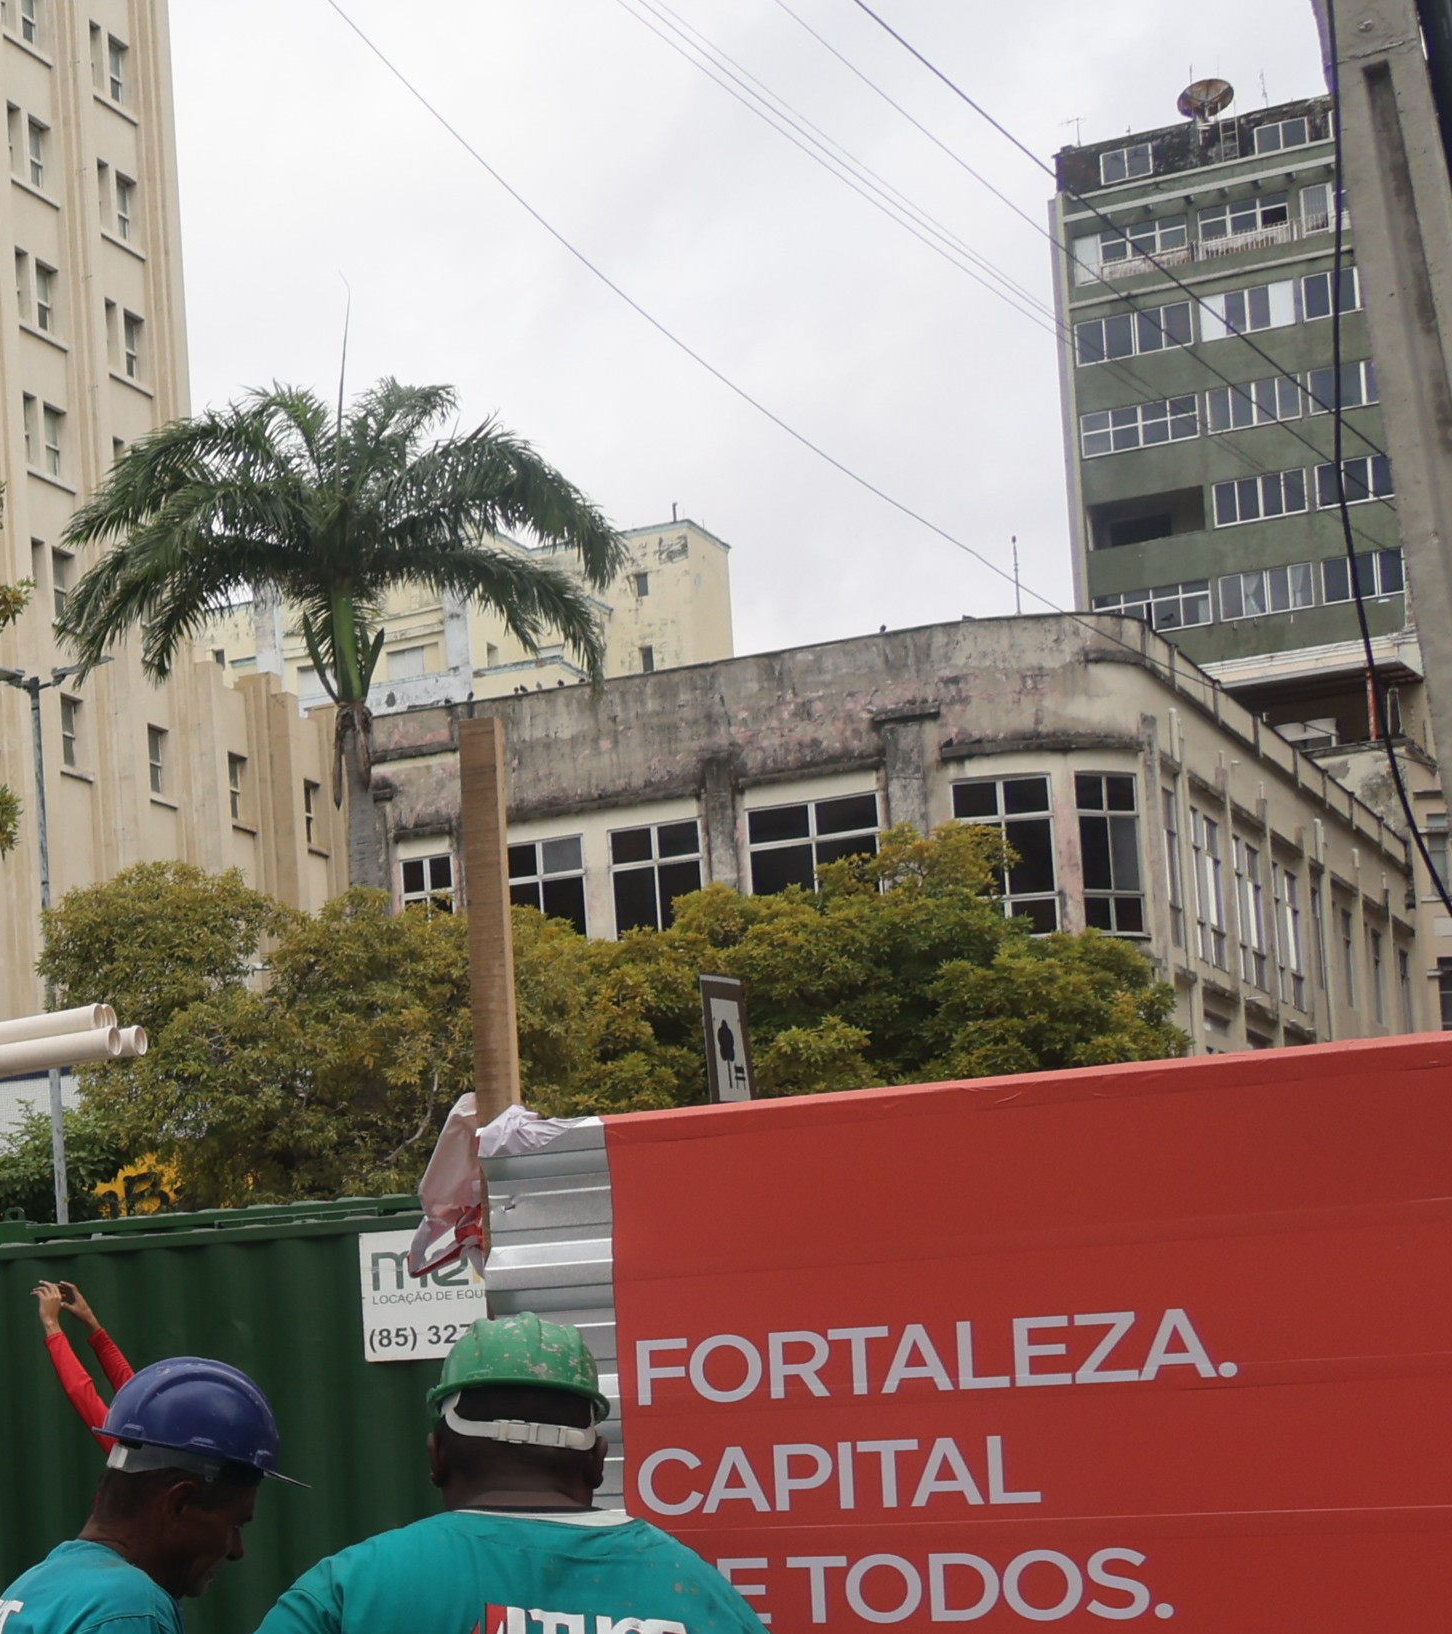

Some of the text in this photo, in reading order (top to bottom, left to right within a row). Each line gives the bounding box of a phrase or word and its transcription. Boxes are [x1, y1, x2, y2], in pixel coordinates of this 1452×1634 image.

[372, 1288, 486, 1305] LOCAÇÃO DE EQU
[369, 1325, 418, 1353] (85)
[635, 1308, 1239, 1407] FORTALEZA.
[636, 1435, 1042, 1517] CAPITAL
[786, 1547, 1175, 1625] TODOS.
